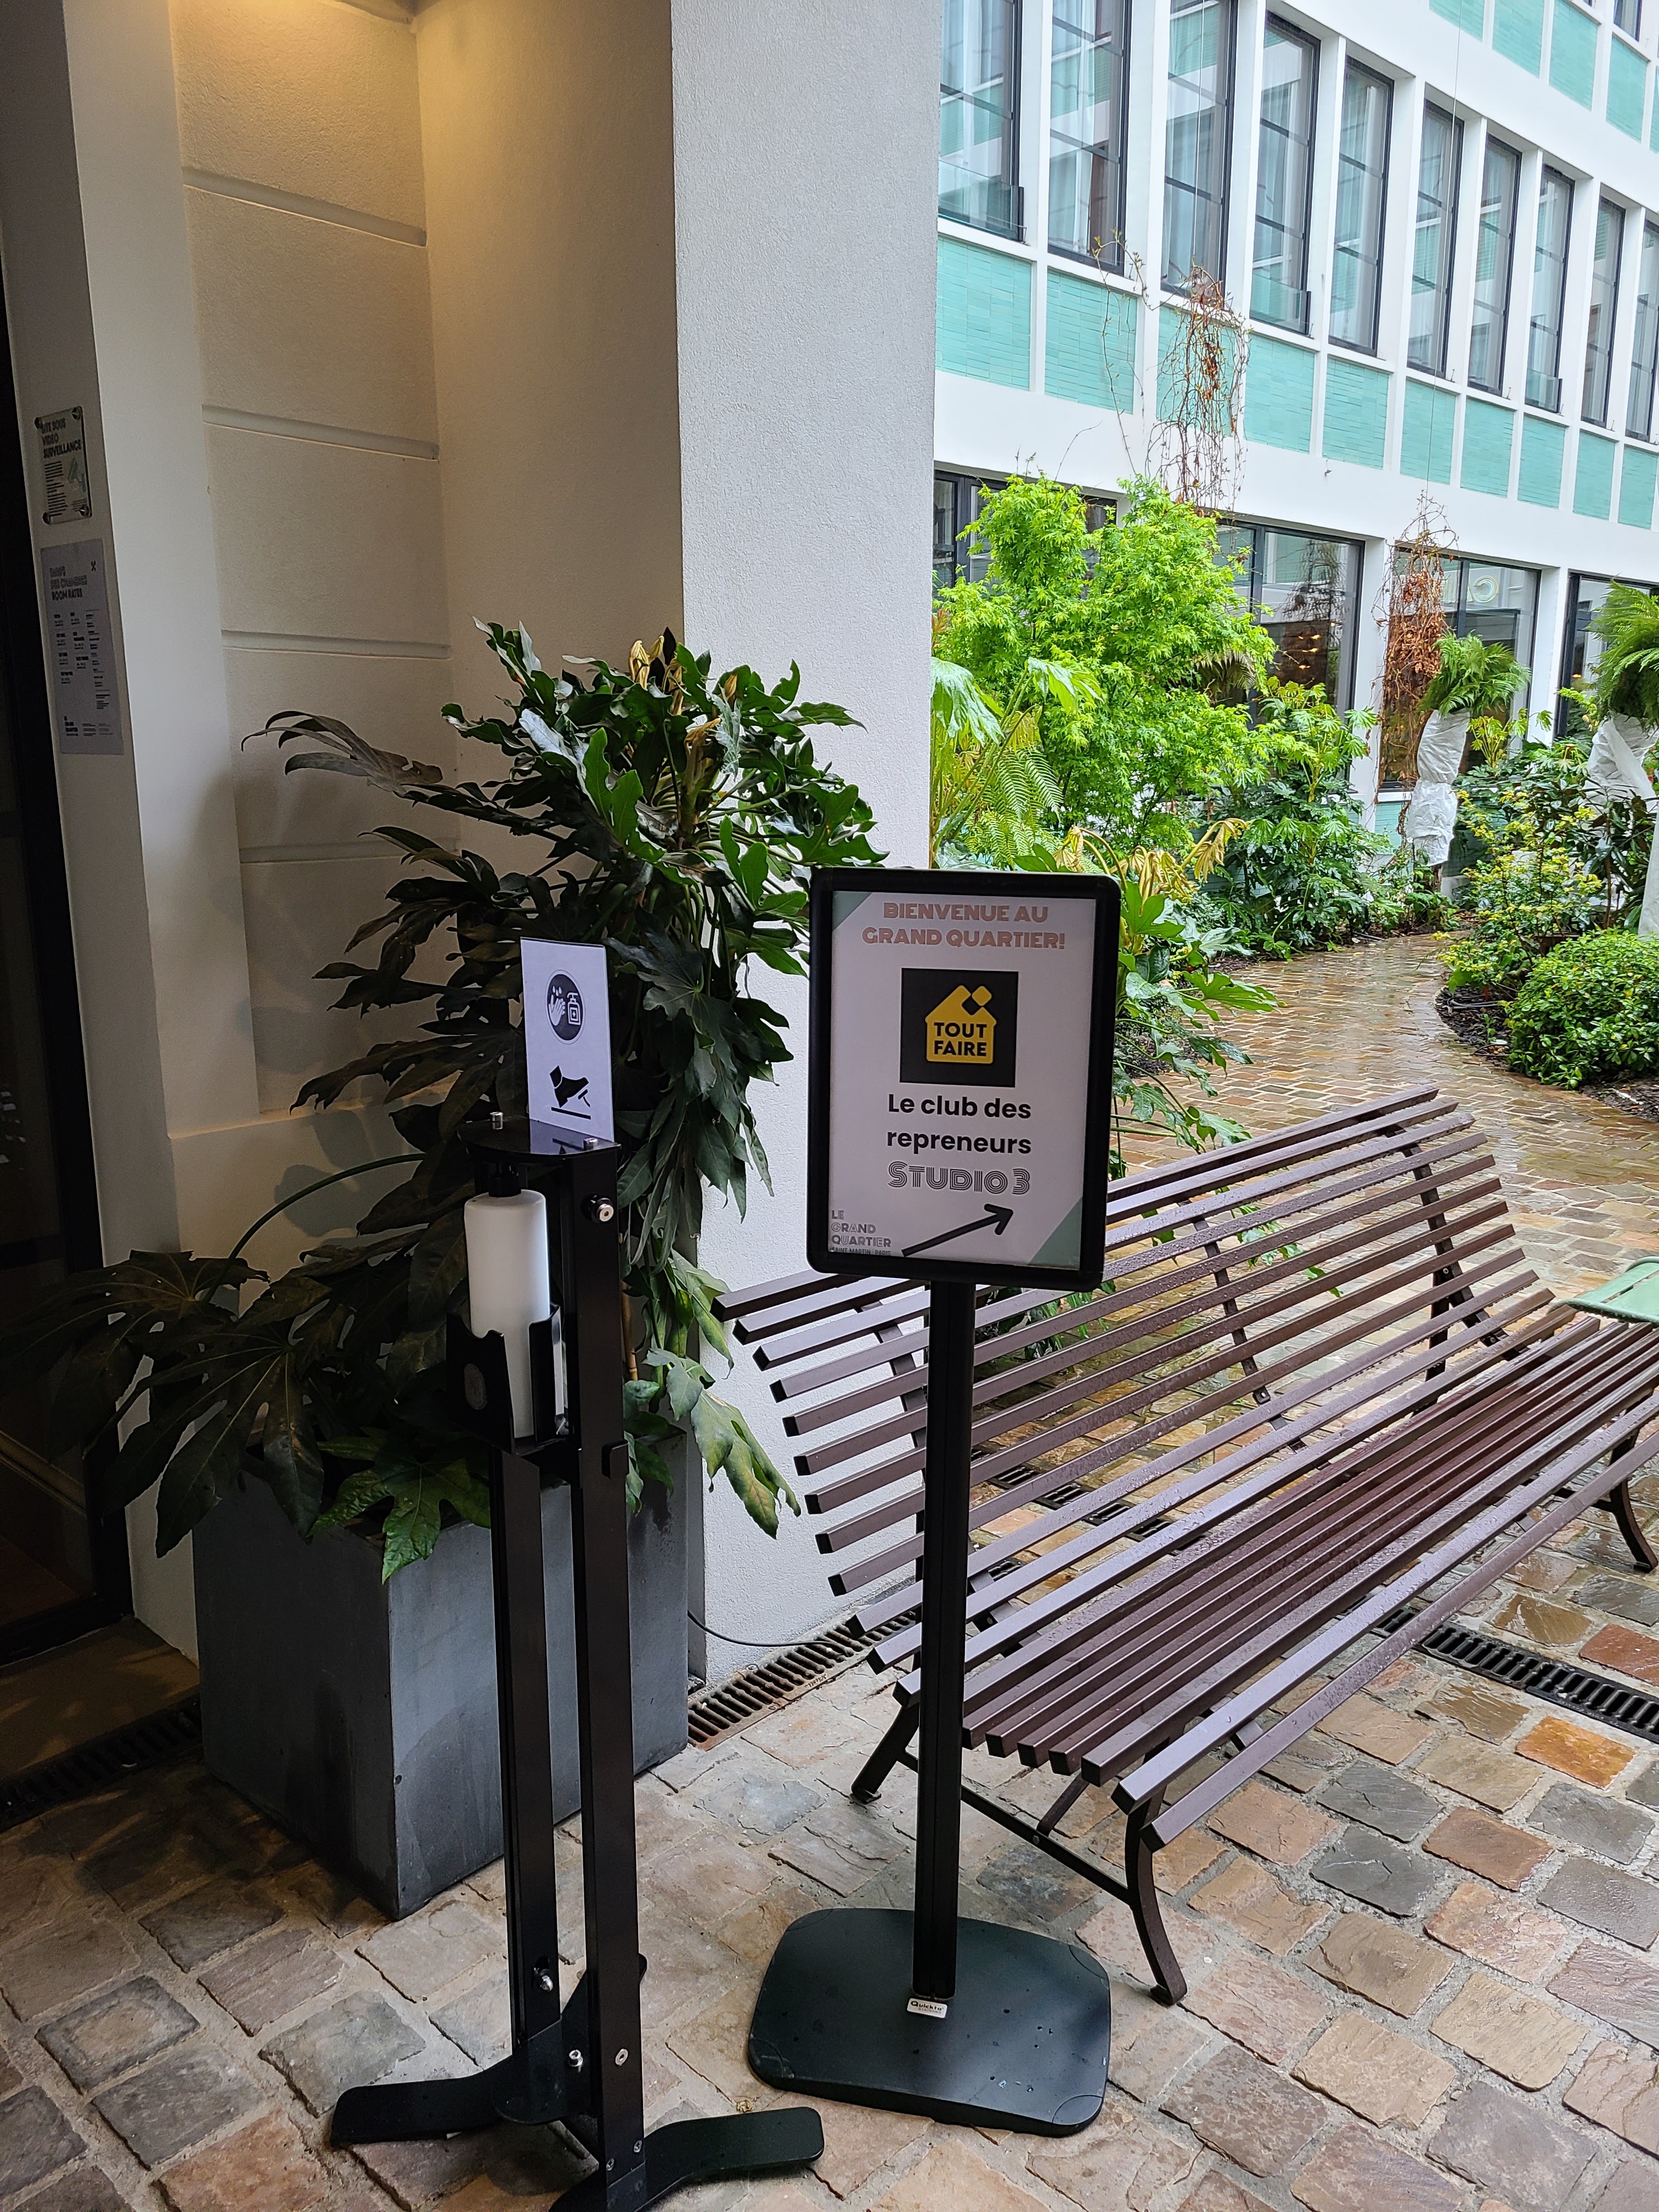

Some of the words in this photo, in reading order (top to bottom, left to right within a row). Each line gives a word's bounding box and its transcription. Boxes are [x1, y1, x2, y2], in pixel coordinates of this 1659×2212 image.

[43, 439, 82, 459] SURVEILLANCE
[52, 590, 67, 601] ROOM
[68, 588, 83, 599] RATES
[883, 902, 1009, 922] BIENVENUE
[1013, 906, 1048, 923] AU
[862, 927, 942, 945] GRAND
[946, 929, 1065, 950] QUARTIER!
[934, 1022, 987, 1038] TOUT
[934, 1040, 986, 1056] FAIRE
[888, 1094, 915, 1113] Le
[921, 1095, 978, 1116] club
[984, 1098, 1031, 1119] des
[887, 1131, 1031, 1154] repreneurs
[888, 1161, 1008, 1194] STUDIO
[1012, 1168, 1030, 1195] 3
[831, 1210, 844, 1220] LE
[831, 1222, 876, 1234] GRAND
[831, 1234, 891, 1248] QUARTIER
